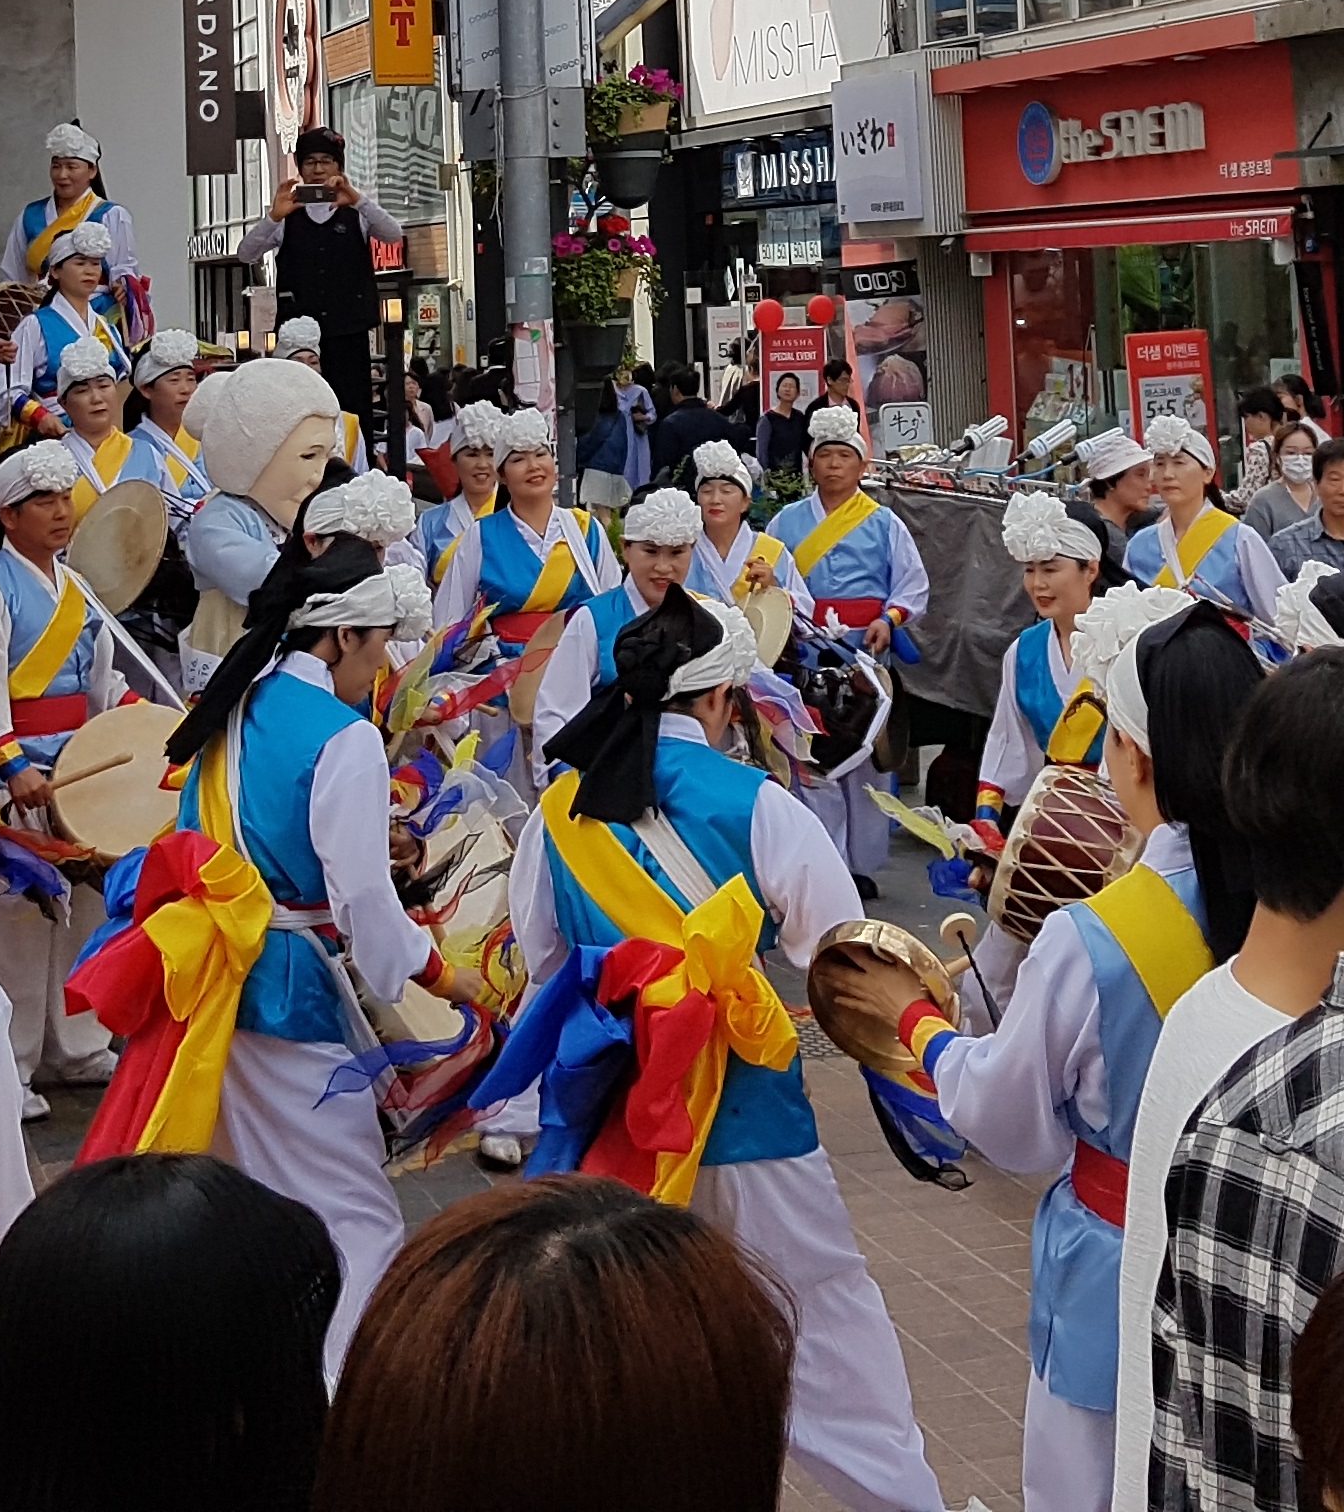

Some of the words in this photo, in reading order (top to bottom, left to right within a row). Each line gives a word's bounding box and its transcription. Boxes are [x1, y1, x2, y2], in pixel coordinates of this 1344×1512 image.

[733, 13, 840, 88] MISSHA
[841, 117, 885, 156] いざわ
[1059, 117, 1106, 164] the
[1100, 101, 1206, 160] SAEM
[1240, 158, 1273, 178] 충장로점
[1229, 221, 1244, 236] the
[1244, 217, 1278, 236] SAEM
[772, 338, 814, 347] MISSHA
[1137, 345, 1162, 361] 더샘
[1164, 342, 1200, 360] 이벤트
[769, 351, 795, 362] SPECIAL
[796, 350, 818, 361] EVENT
[1145, 399, 1177, 419] 5+5
